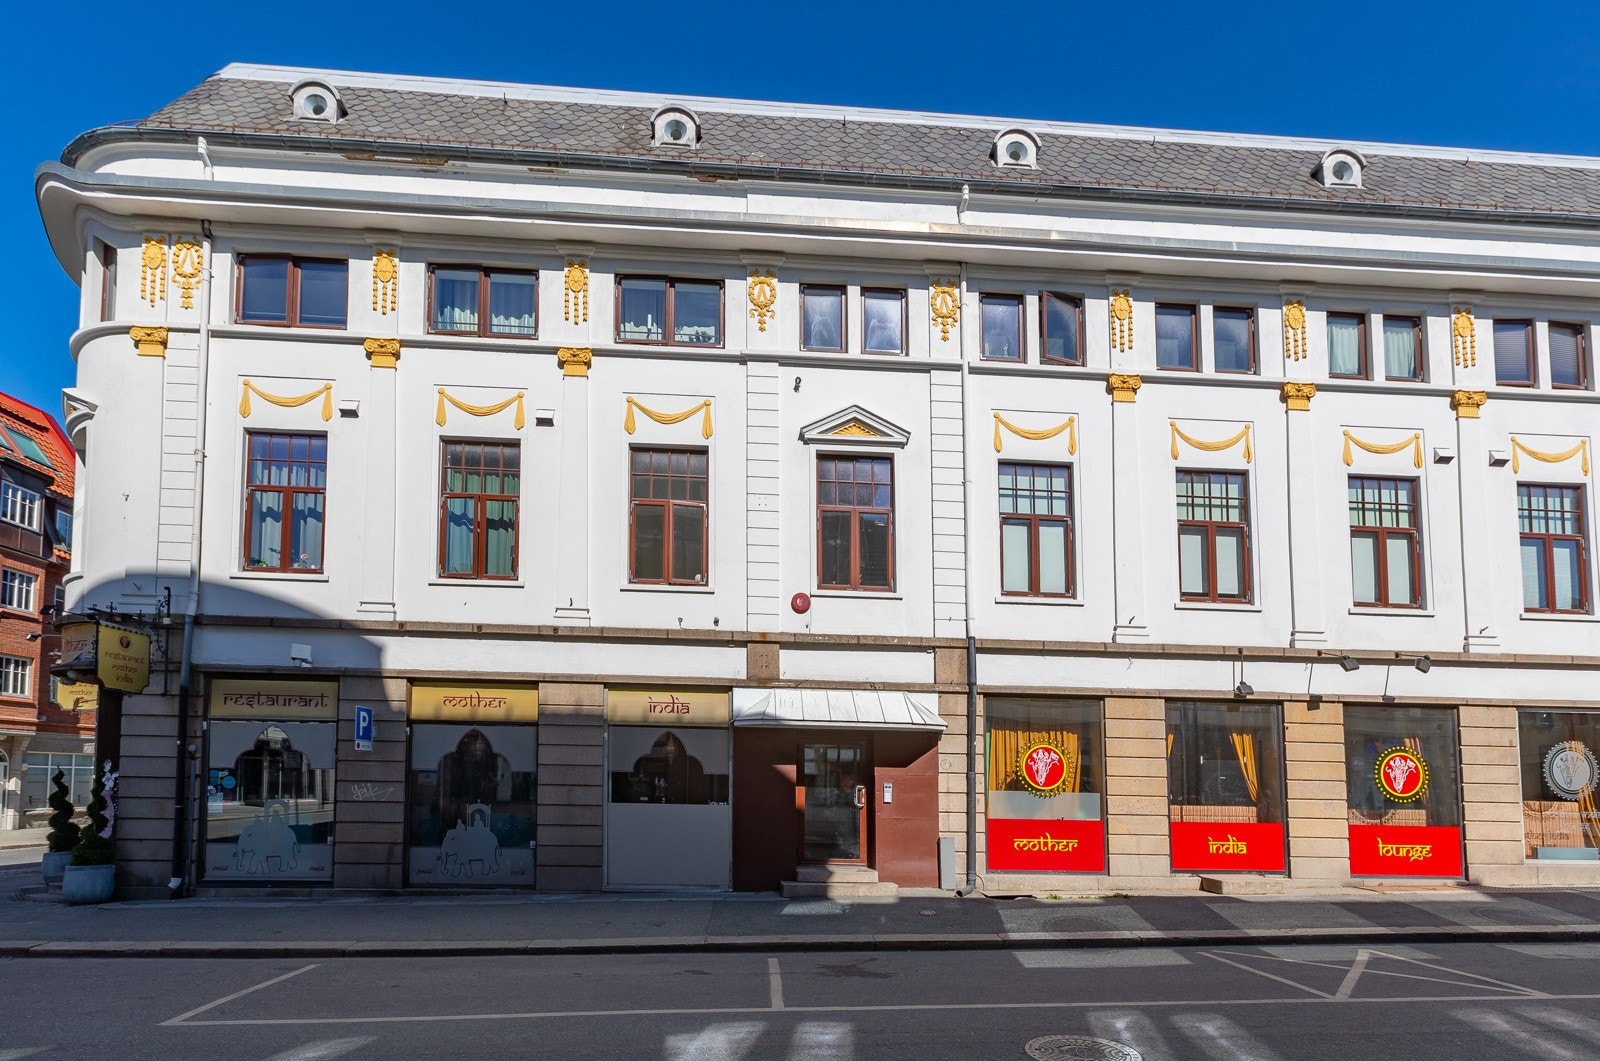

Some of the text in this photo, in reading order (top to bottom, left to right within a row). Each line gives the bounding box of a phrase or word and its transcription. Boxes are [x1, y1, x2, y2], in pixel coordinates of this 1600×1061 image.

[223, 690, 329, 709] restaurant
[443, 691, 506, 708] mother
[648, 694, 690, 714] india
[359, 711, 369, 736] P
[1013, 832, 1079, 852] mother
[1207, 834, 1247, 855] india
[1377, 837, 1433, 862] lounge
